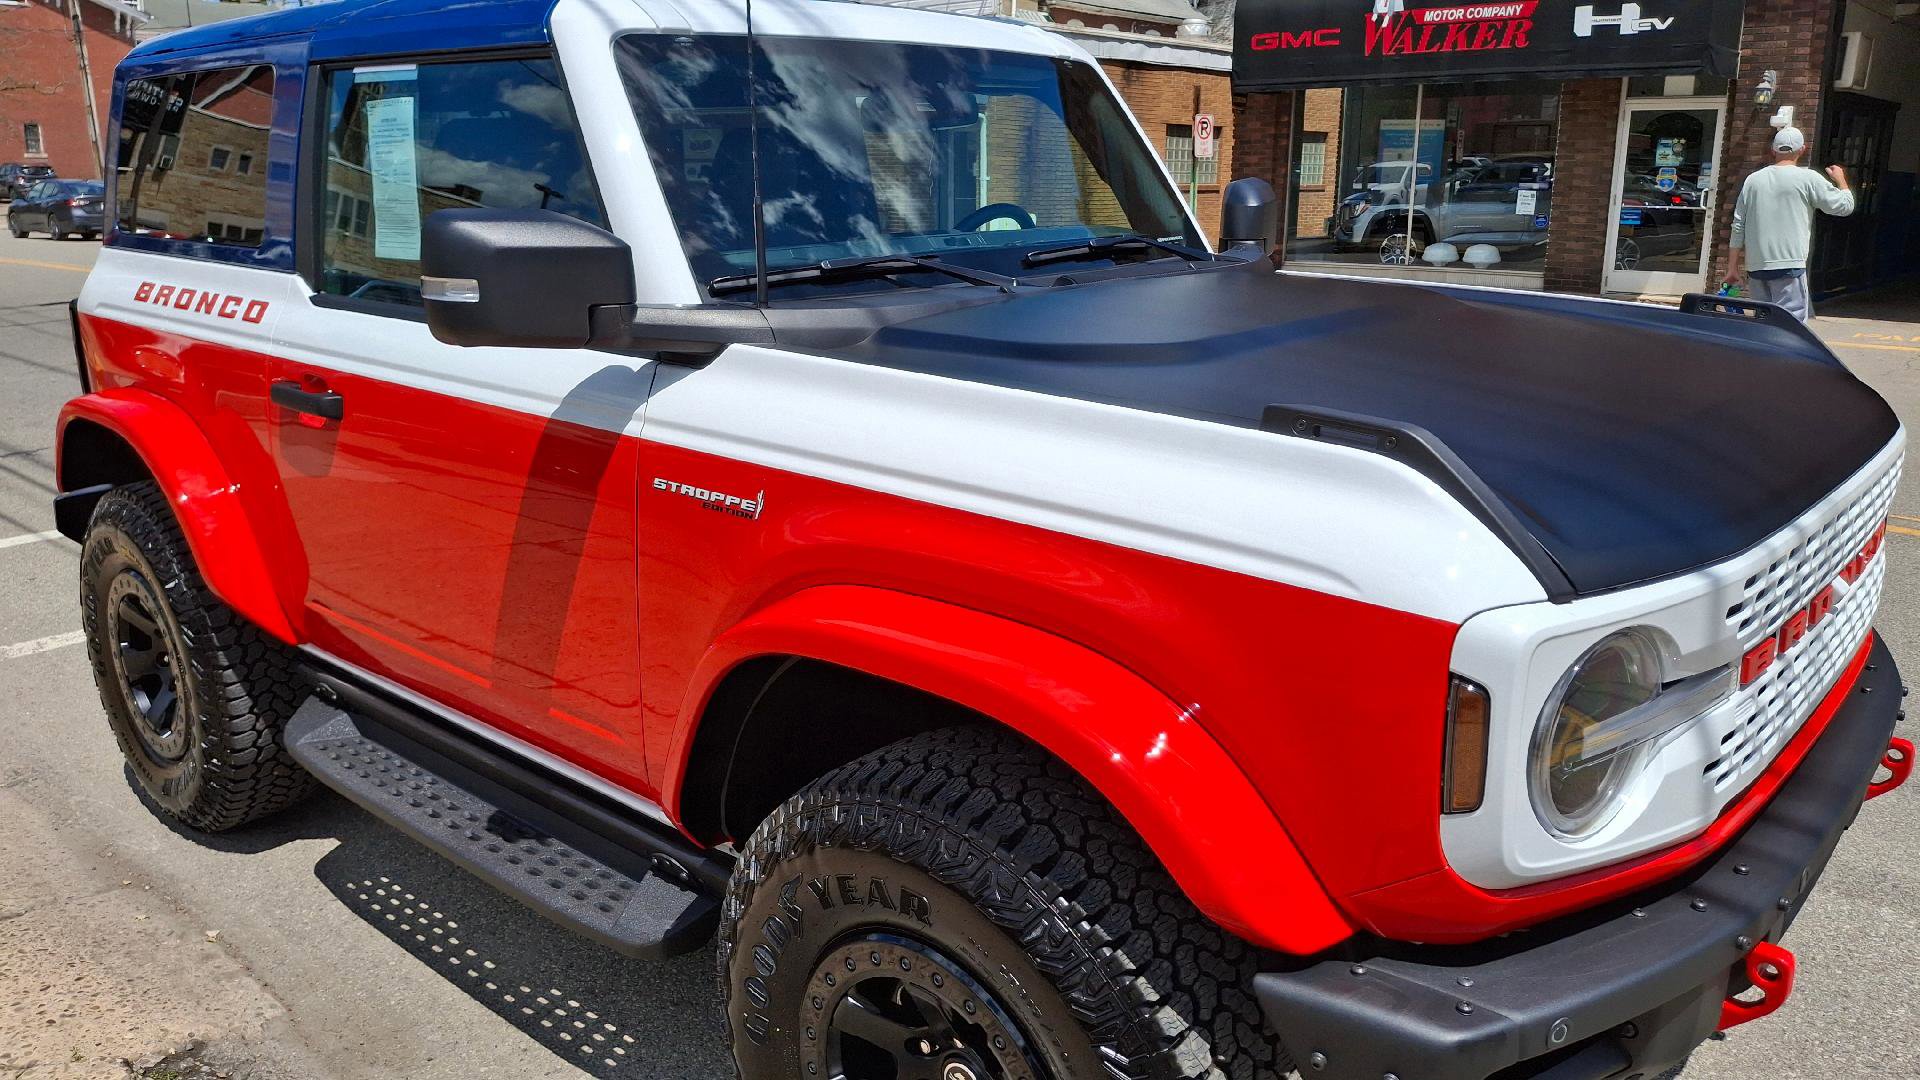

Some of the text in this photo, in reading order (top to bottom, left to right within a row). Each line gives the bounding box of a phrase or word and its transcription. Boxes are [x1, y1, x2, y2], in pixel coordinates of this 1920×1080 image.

[1424, 4, 1524, 22] MOTOR COMPANY
[1251, 28, 1341, 51] GMC
[1364, 11, 1534, 57] WALKER
[133, 281, 270, 324] BRONCO
[653, 477, 757, 512] STROPPE
[701, 501, 754, 520] EDITION
